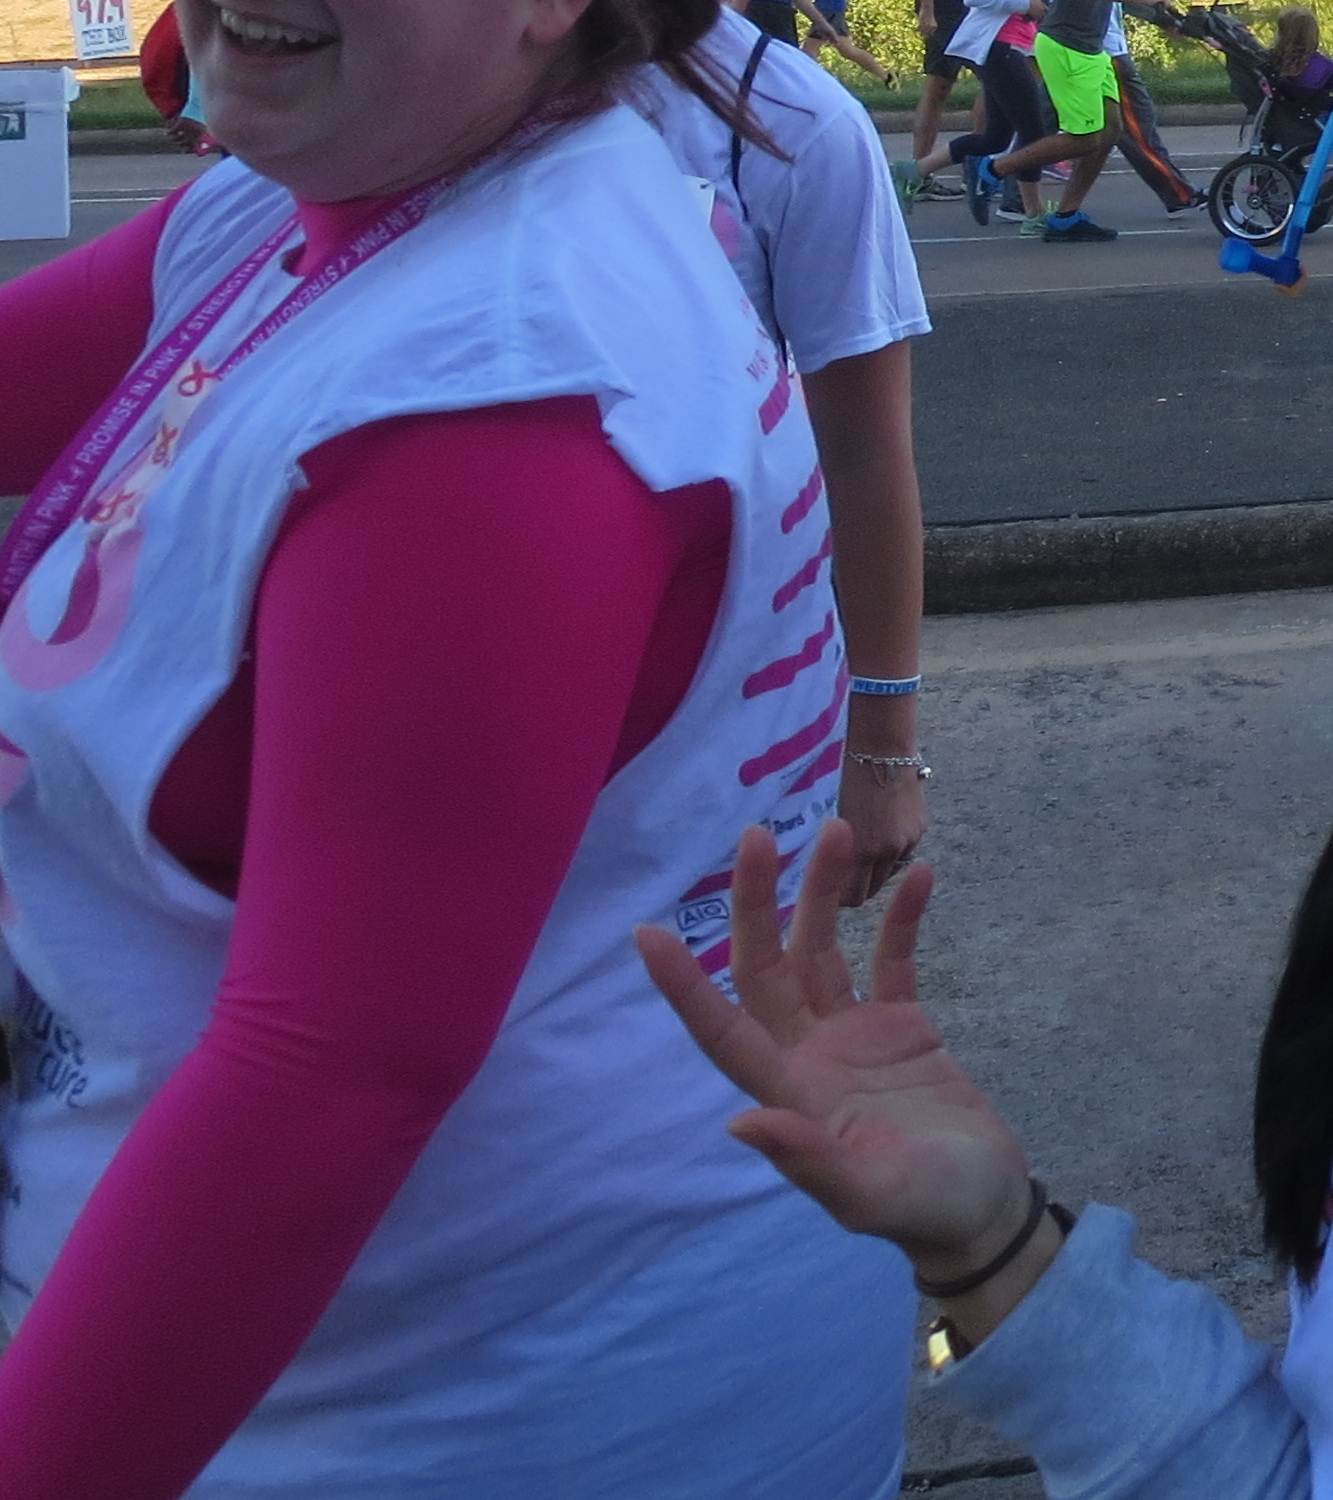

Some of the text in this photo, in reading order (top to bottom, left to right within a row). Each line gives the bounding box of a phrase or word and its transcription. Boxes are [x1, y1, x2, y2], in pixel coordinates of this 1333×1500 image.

[75, 397, 141, 466] PROMISE
[129, 380, 152, 396] IN
[144, 346, 184, 380] PINK
[187, 262, 256, 330] STRENGTH
[264, 263, 340, 336] STRENGTH
